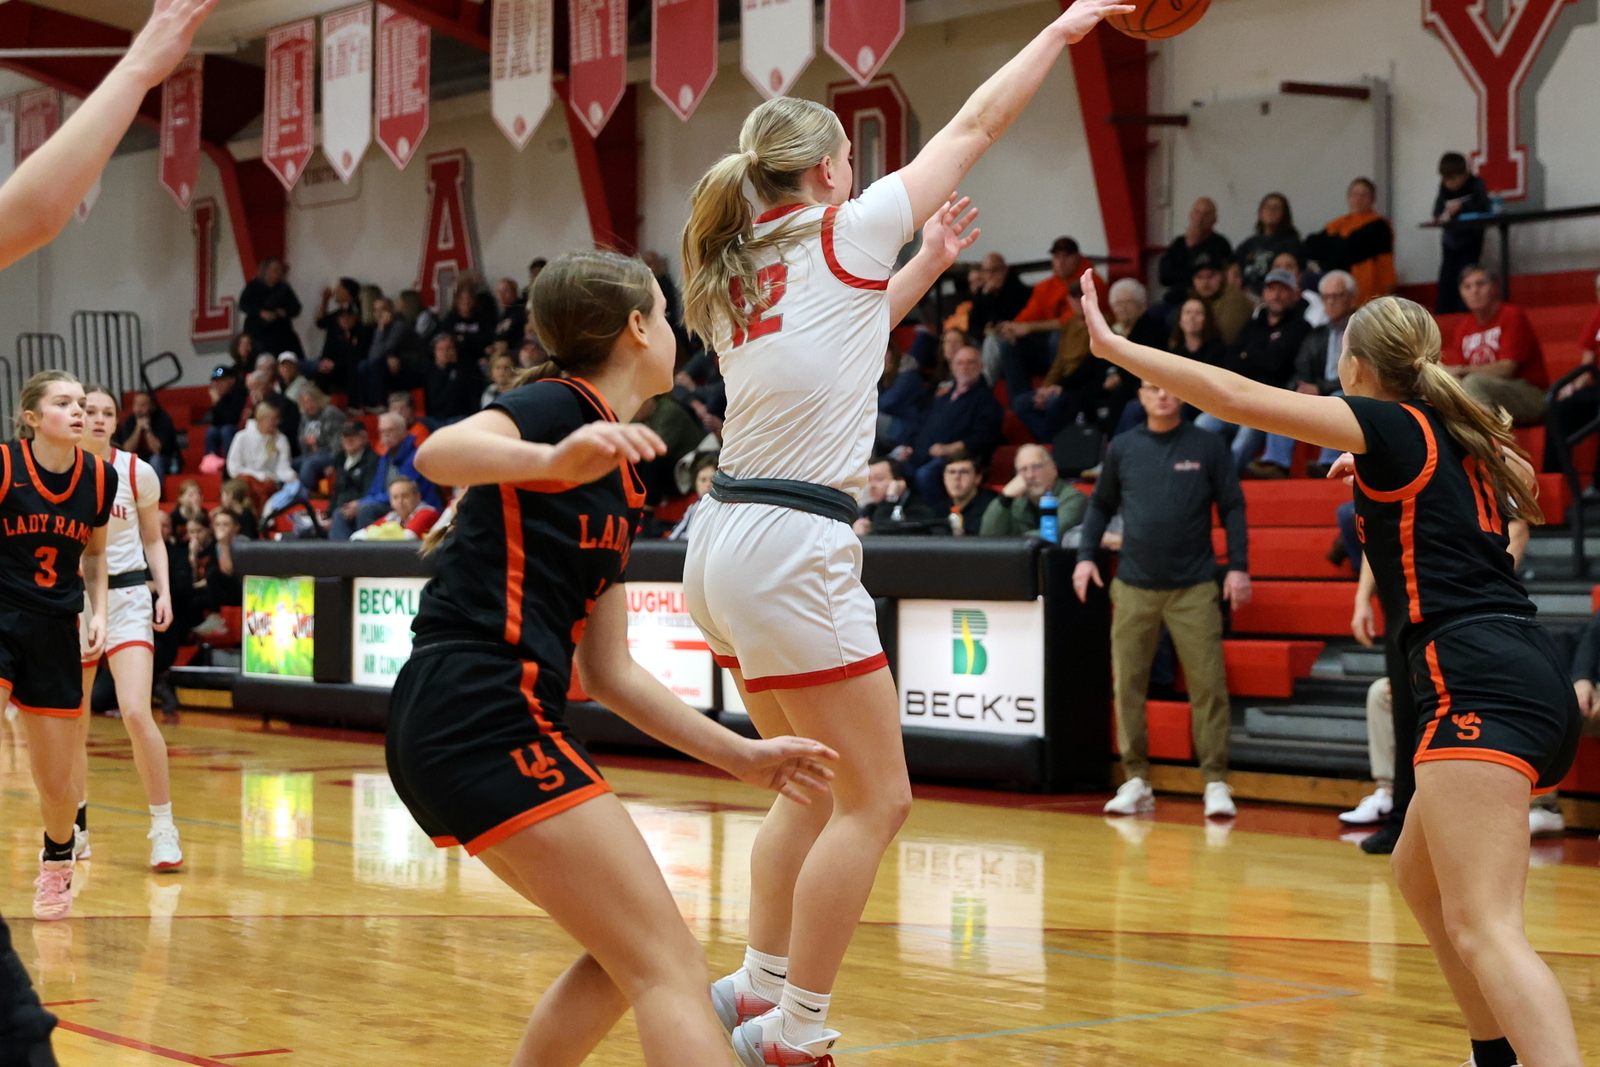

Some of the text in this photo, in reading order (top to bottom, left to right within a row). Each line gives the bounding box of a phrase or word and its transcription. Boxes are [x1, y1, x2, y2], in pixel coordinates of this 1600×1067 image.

[1422, 0, 1579, 202] Y
[415, 149, 476, 314] A
[191, 196, 235, 344] L
[2, 513, 50, 537] LADY
[33, 545, 59, 588] 3
[358, 588, 421, 615] BECKL
[905, 690, 1037, 723] BECK'S
